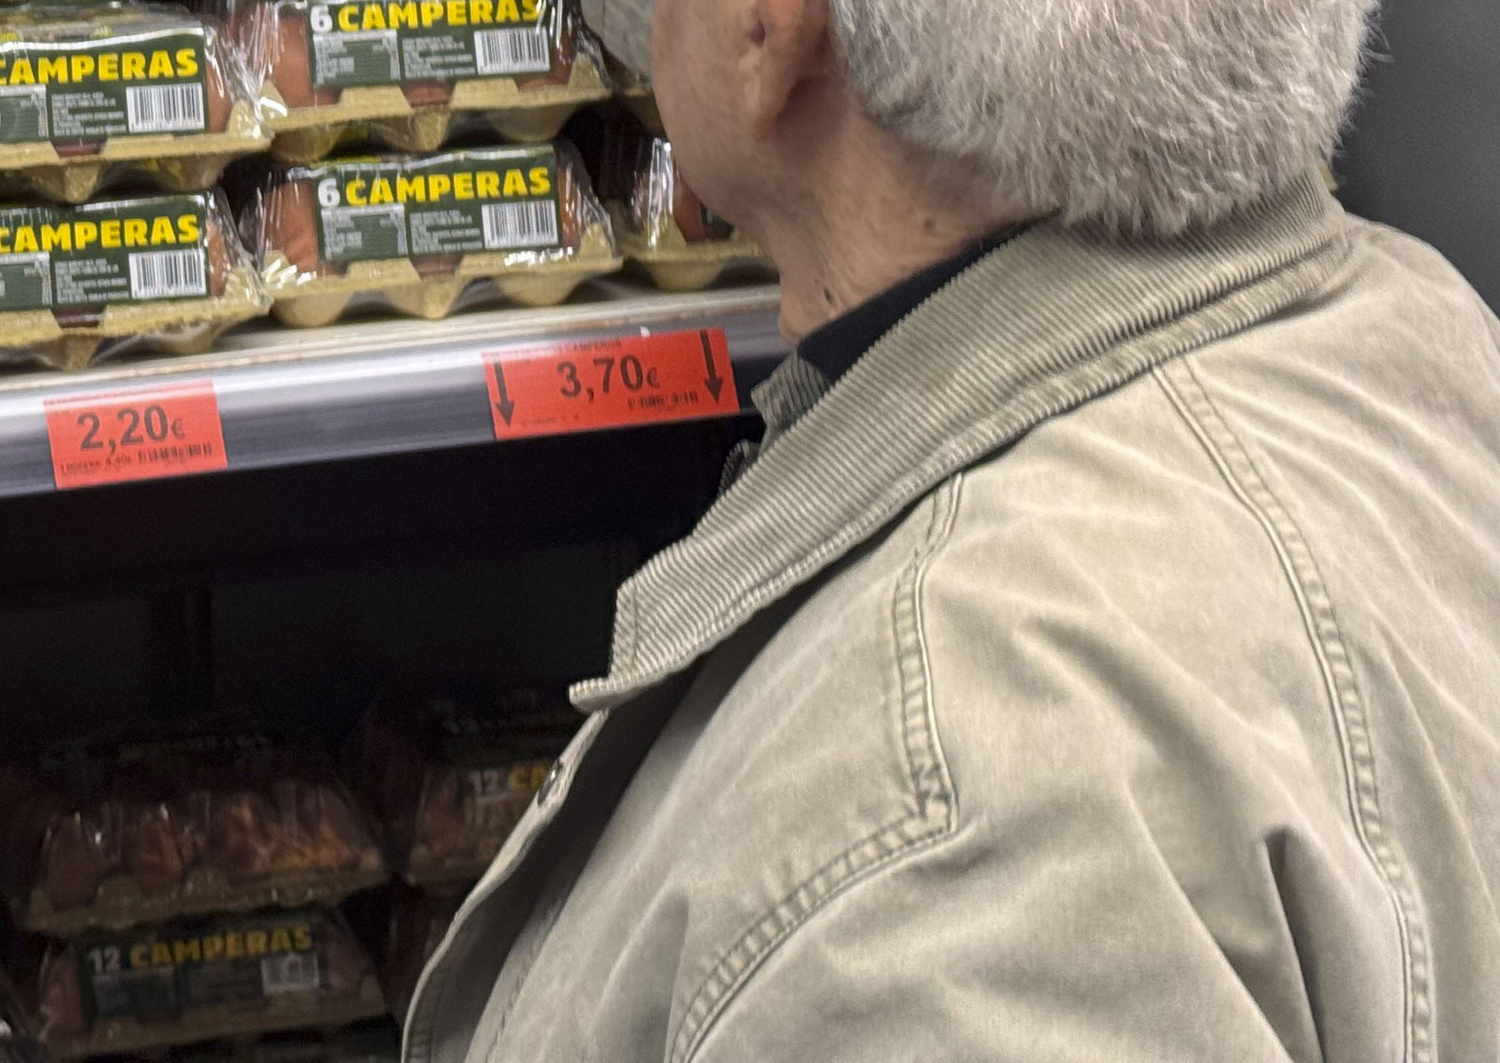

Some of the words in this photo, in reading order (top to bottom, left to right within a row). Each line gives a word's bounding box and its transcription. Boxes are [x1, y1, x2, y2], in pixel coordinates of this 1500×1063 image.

[310, 4, 333, 33] 6
[318, 178, 341, 207] 6
[345, 166, 551, 207] CAMPERAS
[557, 354, 660, 404] 3,70€
[77, 404, 185, 455] 2,20€
[88, 945, 122, 973] 12
[129, 922, 313, 967] CAMPERAS
